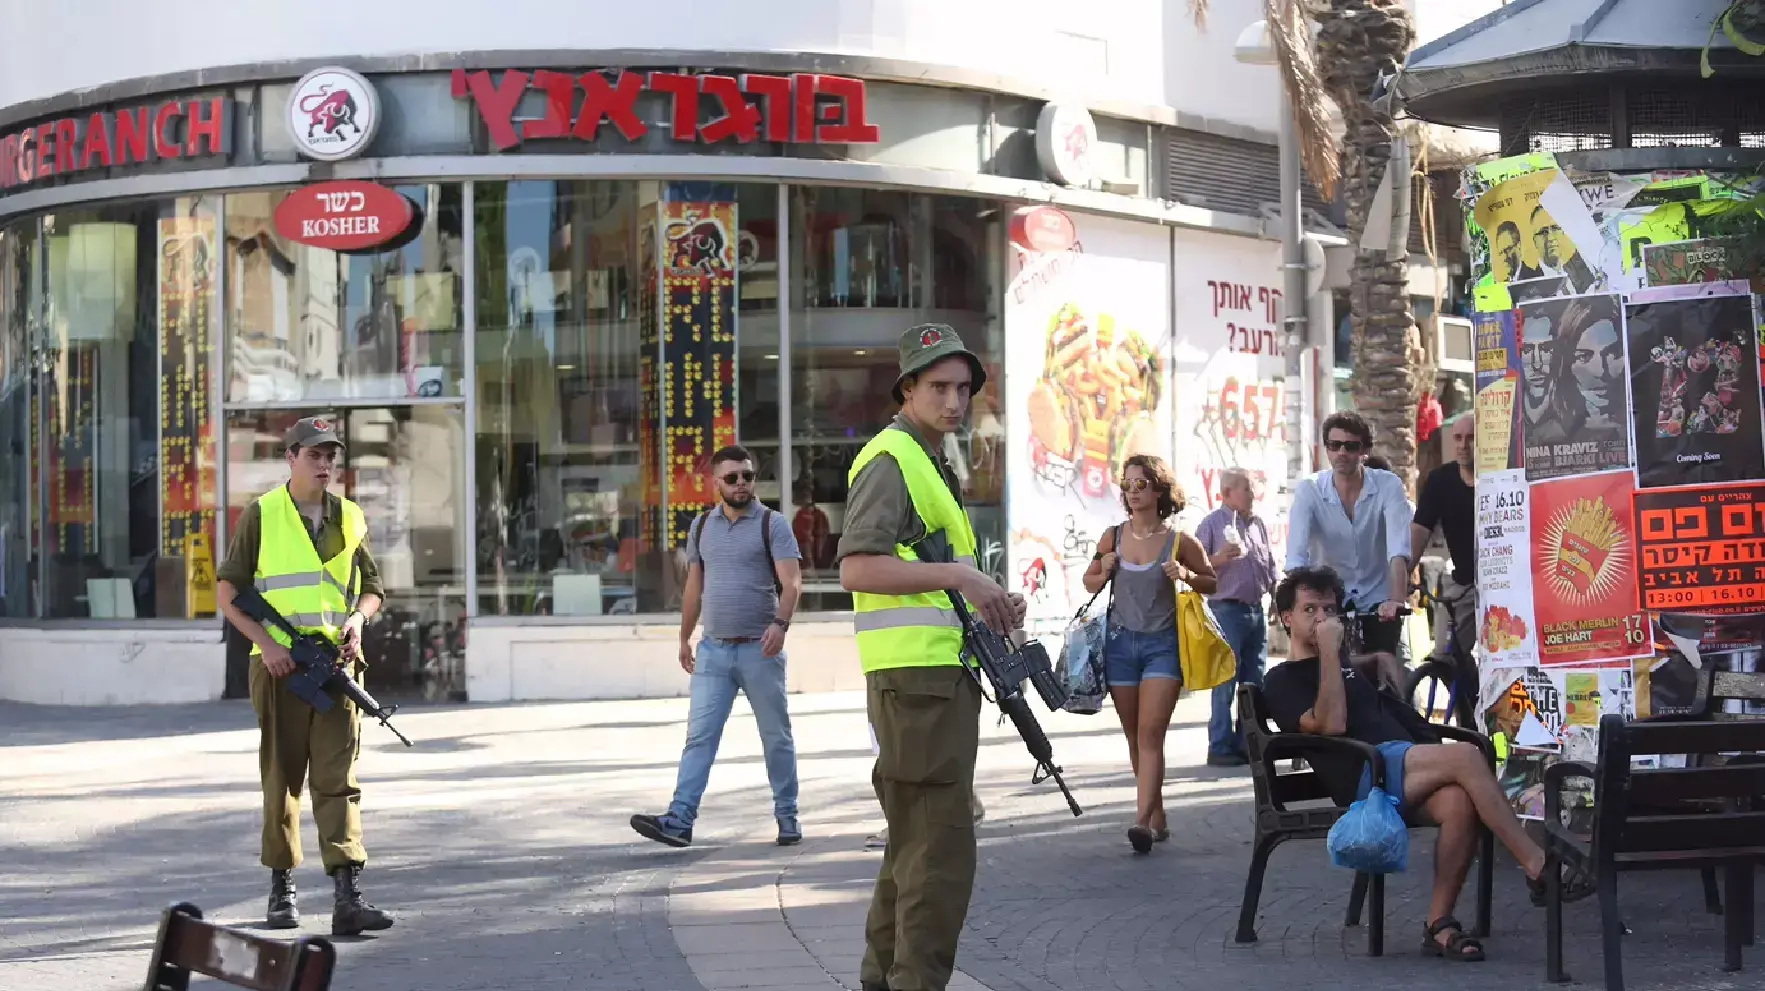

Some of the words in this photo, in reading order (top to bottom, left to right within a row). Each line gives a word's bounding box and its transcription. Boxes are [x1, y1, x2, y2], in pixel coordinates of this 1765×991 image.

[452, 69, 880, 149] בורגראנץ'
[0, 96, 223, 187] RGERANCH
[316, 191, 365, 213] כשר
[302, 216, 380, 237] KOSHER
[1207, 280, 1252, 317] אותך
[1525, 446, 1550, 459] NINA
[1553, 442, 1599, 456] KRAVIZ
[1676, 454, 1702, 463] Coming
[1704, 452, 1721, 460] Soon
[1496, 491, 1525, 509] 16.10
[1645, 546, 1712, 566] קיסר
[1644, 571, 1700, 587] אביב
[1712, 567, 1742, 581] תל
[1648, 591, 1694, 604] 13:00
[1711, 588, 1755, 600] 16.10
[1544, 621, 1576, 633] BLACK
[1579, 616, 1619, 630] MERLIN
[1622, 615, 1641, 630] 17
[1545, 634, 1563, 645] JOE
[1565, 631, 1592, 643] HART
[1625, 630, 1645, 644] 10
